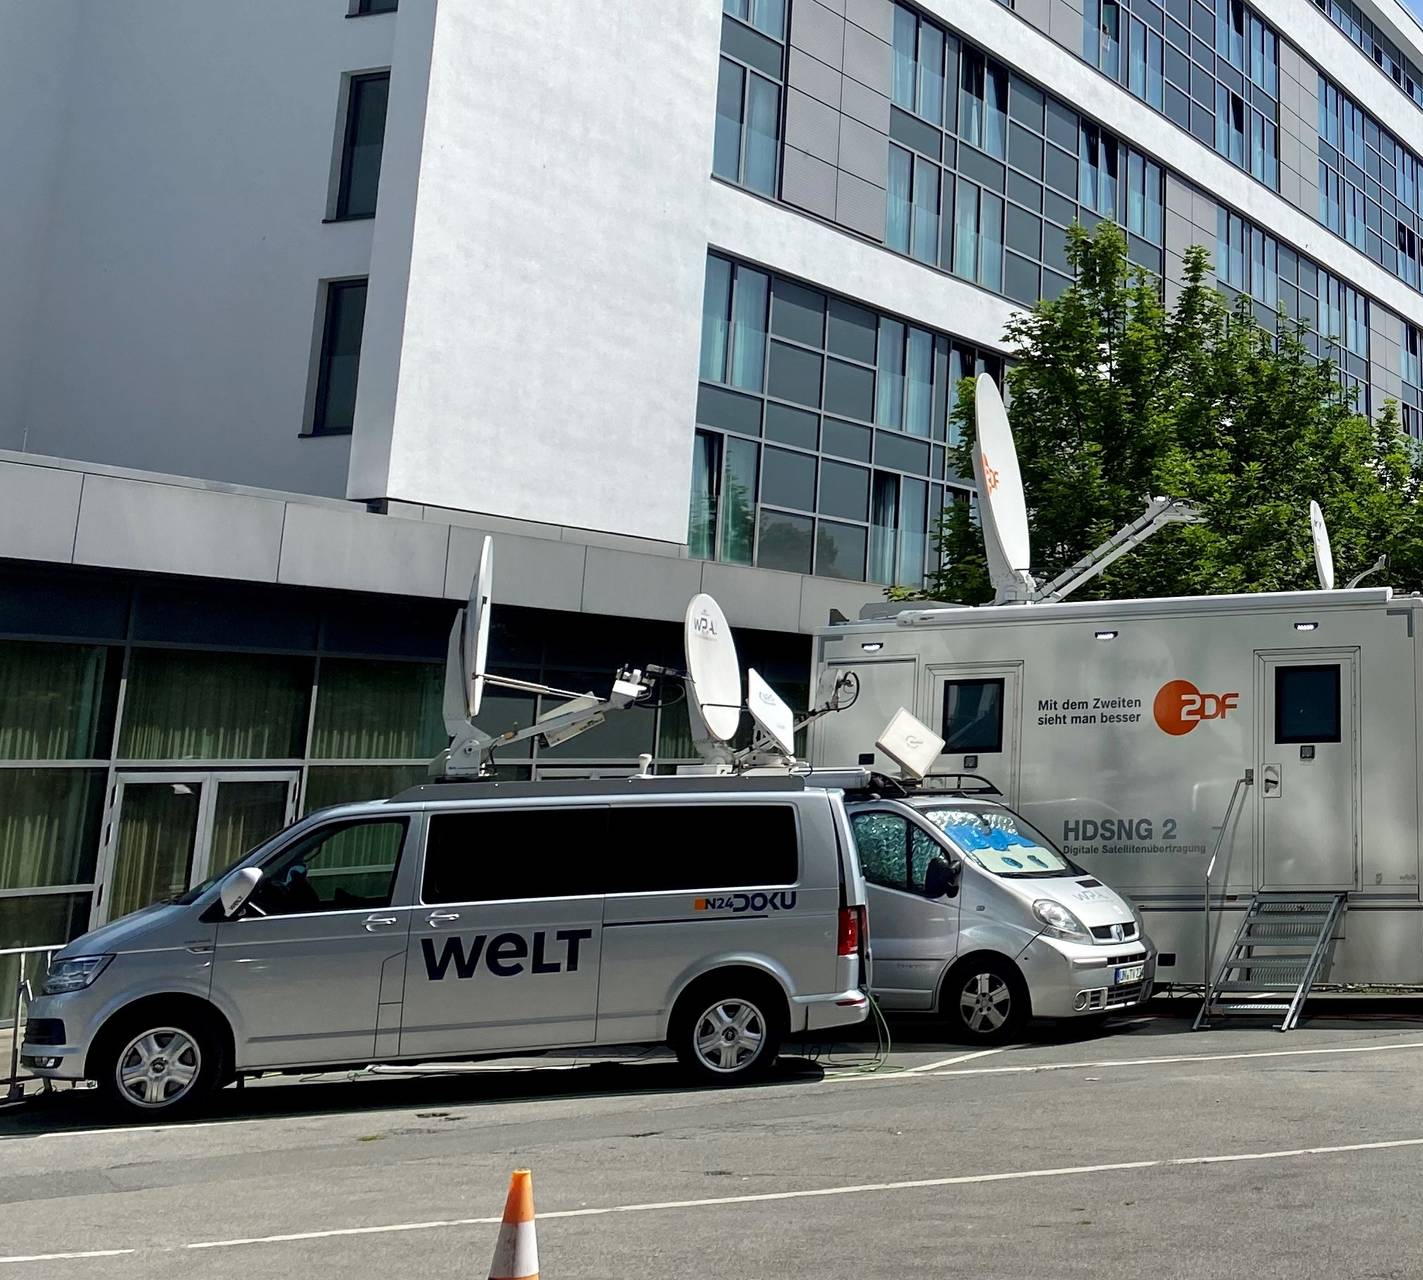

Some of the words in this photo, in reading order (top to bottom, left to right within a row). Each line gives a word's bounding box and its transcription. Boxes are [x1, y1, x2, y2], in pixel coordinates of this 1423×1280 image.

[1038, 700, 1058, 711] Mit
[1062, 699, 1089, 710] dem
[1092, 697, 1142, 710] Zweiten
[1181, 693, 1240, 721] ZDF
[1038, 713, 1067, 726] sieht
[1071, 714, 1097, 725] man
[1100, 712, 1141, 724] besser
[1063, 819, 1153, 841] HDSNG
[1162, 818, 1177, 840] 2
[1063, 845, 1099, 856] Digitale
[705, 899, 734, 911] N24
[733, 891, 797, 913] DOKU
